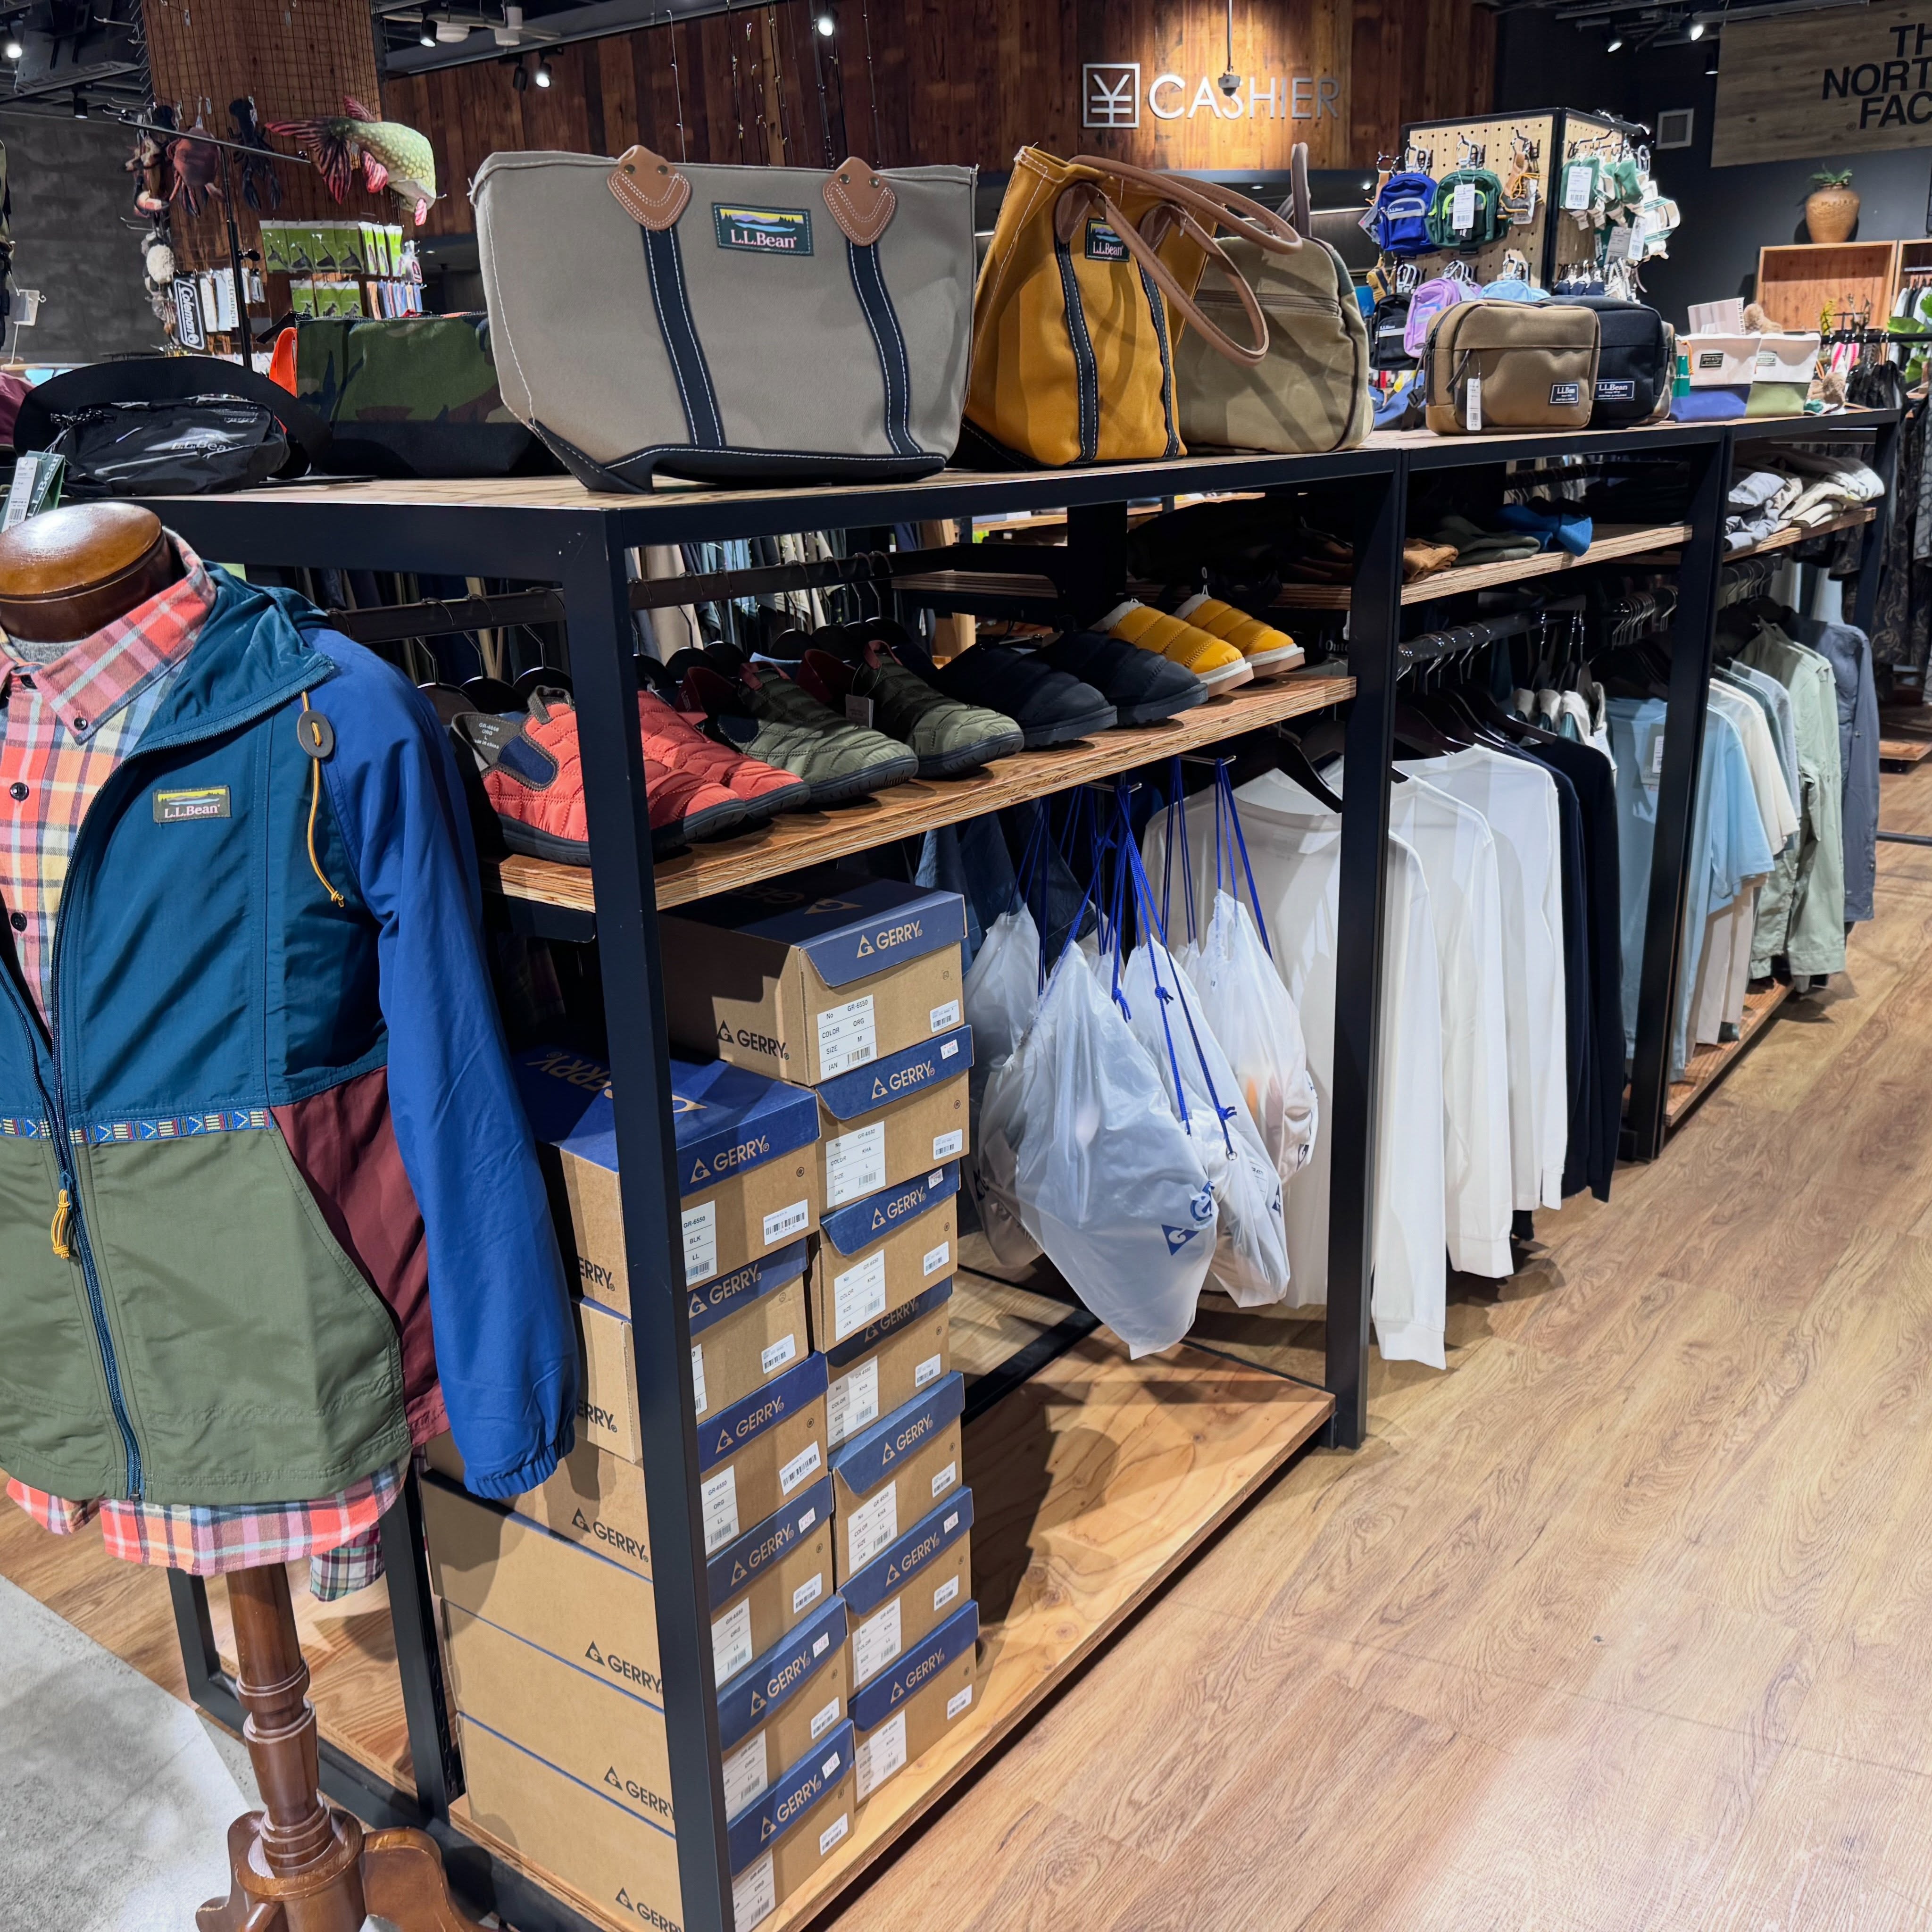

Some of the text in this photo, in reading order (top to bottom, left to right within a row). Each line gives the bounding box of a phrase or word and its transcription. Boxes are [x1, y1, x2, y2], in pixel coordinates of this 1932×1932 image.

[1890, 23, 1932, 58] TH
[1822, 56, 1932, 100] NORT
[1859, 91, 1932, 130] FAC
[731, 229, 796, 249] L.L.Bean
[1093, 241, 1123, 256] L.L.Bean
[181, 287, 195, 333] Coleman
[165, 804, 220, 818] L.L.Bean
[876, 920, 920, 950] GERRY
[737, 1029, 786, 1059] GERRY
[822, 1018, 864, 1038] COLOR ORG
[826, 1045, 838, 1055] SIZE
[829, 1062, 838, 1071] JAN
[889, 1060, 931, 1090] GERRY
[714, 1135, 766, 1172] GERRY
[887, 1186, 924, 1219] GERRY
[683, 1216, 706, 1228] GR-6550
[690, 1235, 701, 1244] BLK
[578, 1256, 612, 1286] ERRY
[709, 1264, 758, 1305] GERRY
[578, 1400, 615, 1432] ERRY
[736, 1396, 782, 1438] GERRY
[897, 1413, 930, 1451] GERRY
[593, 1520, 646, 1560] GERRY
[749, 1523, 791, 1569] GERRY
[901, 1532, 937, 1572] GERRY
[608, 1654, 661, 1693] GERRY
[767, 1650, 807, 1698] GERRY
[906, 1648, 942, 1689] GERRY
[777, 1774, 818, 1823] GERRY
